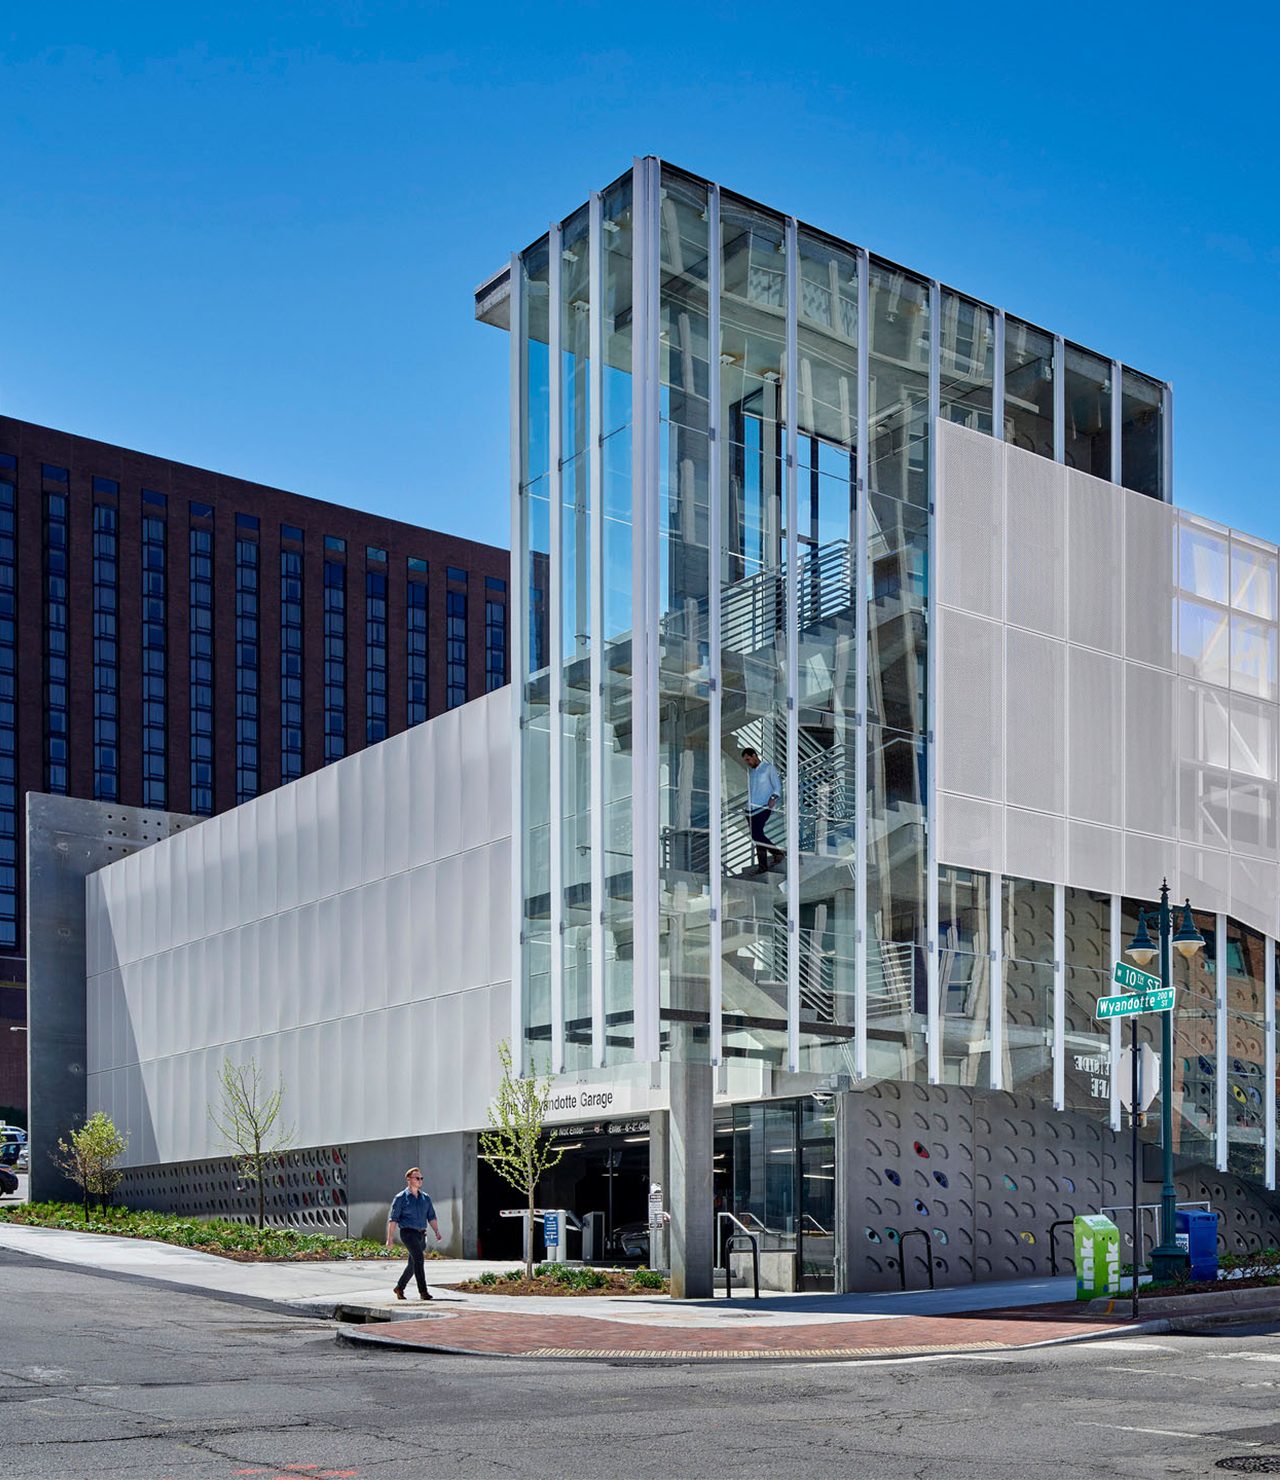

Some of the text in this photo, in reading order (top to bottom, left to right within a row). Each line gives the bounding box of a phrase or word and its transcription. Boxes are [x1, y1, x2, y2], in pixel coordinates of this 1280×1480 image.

[1146, 978, 1160, 992] ST
[1100, 996, 1155, 1015] Wyandotte
[580, 1091, 613, 1109] Garage
[1080, 1236, 1095, 1290] ink
[1106, 1242, 1119, 1293] ink
